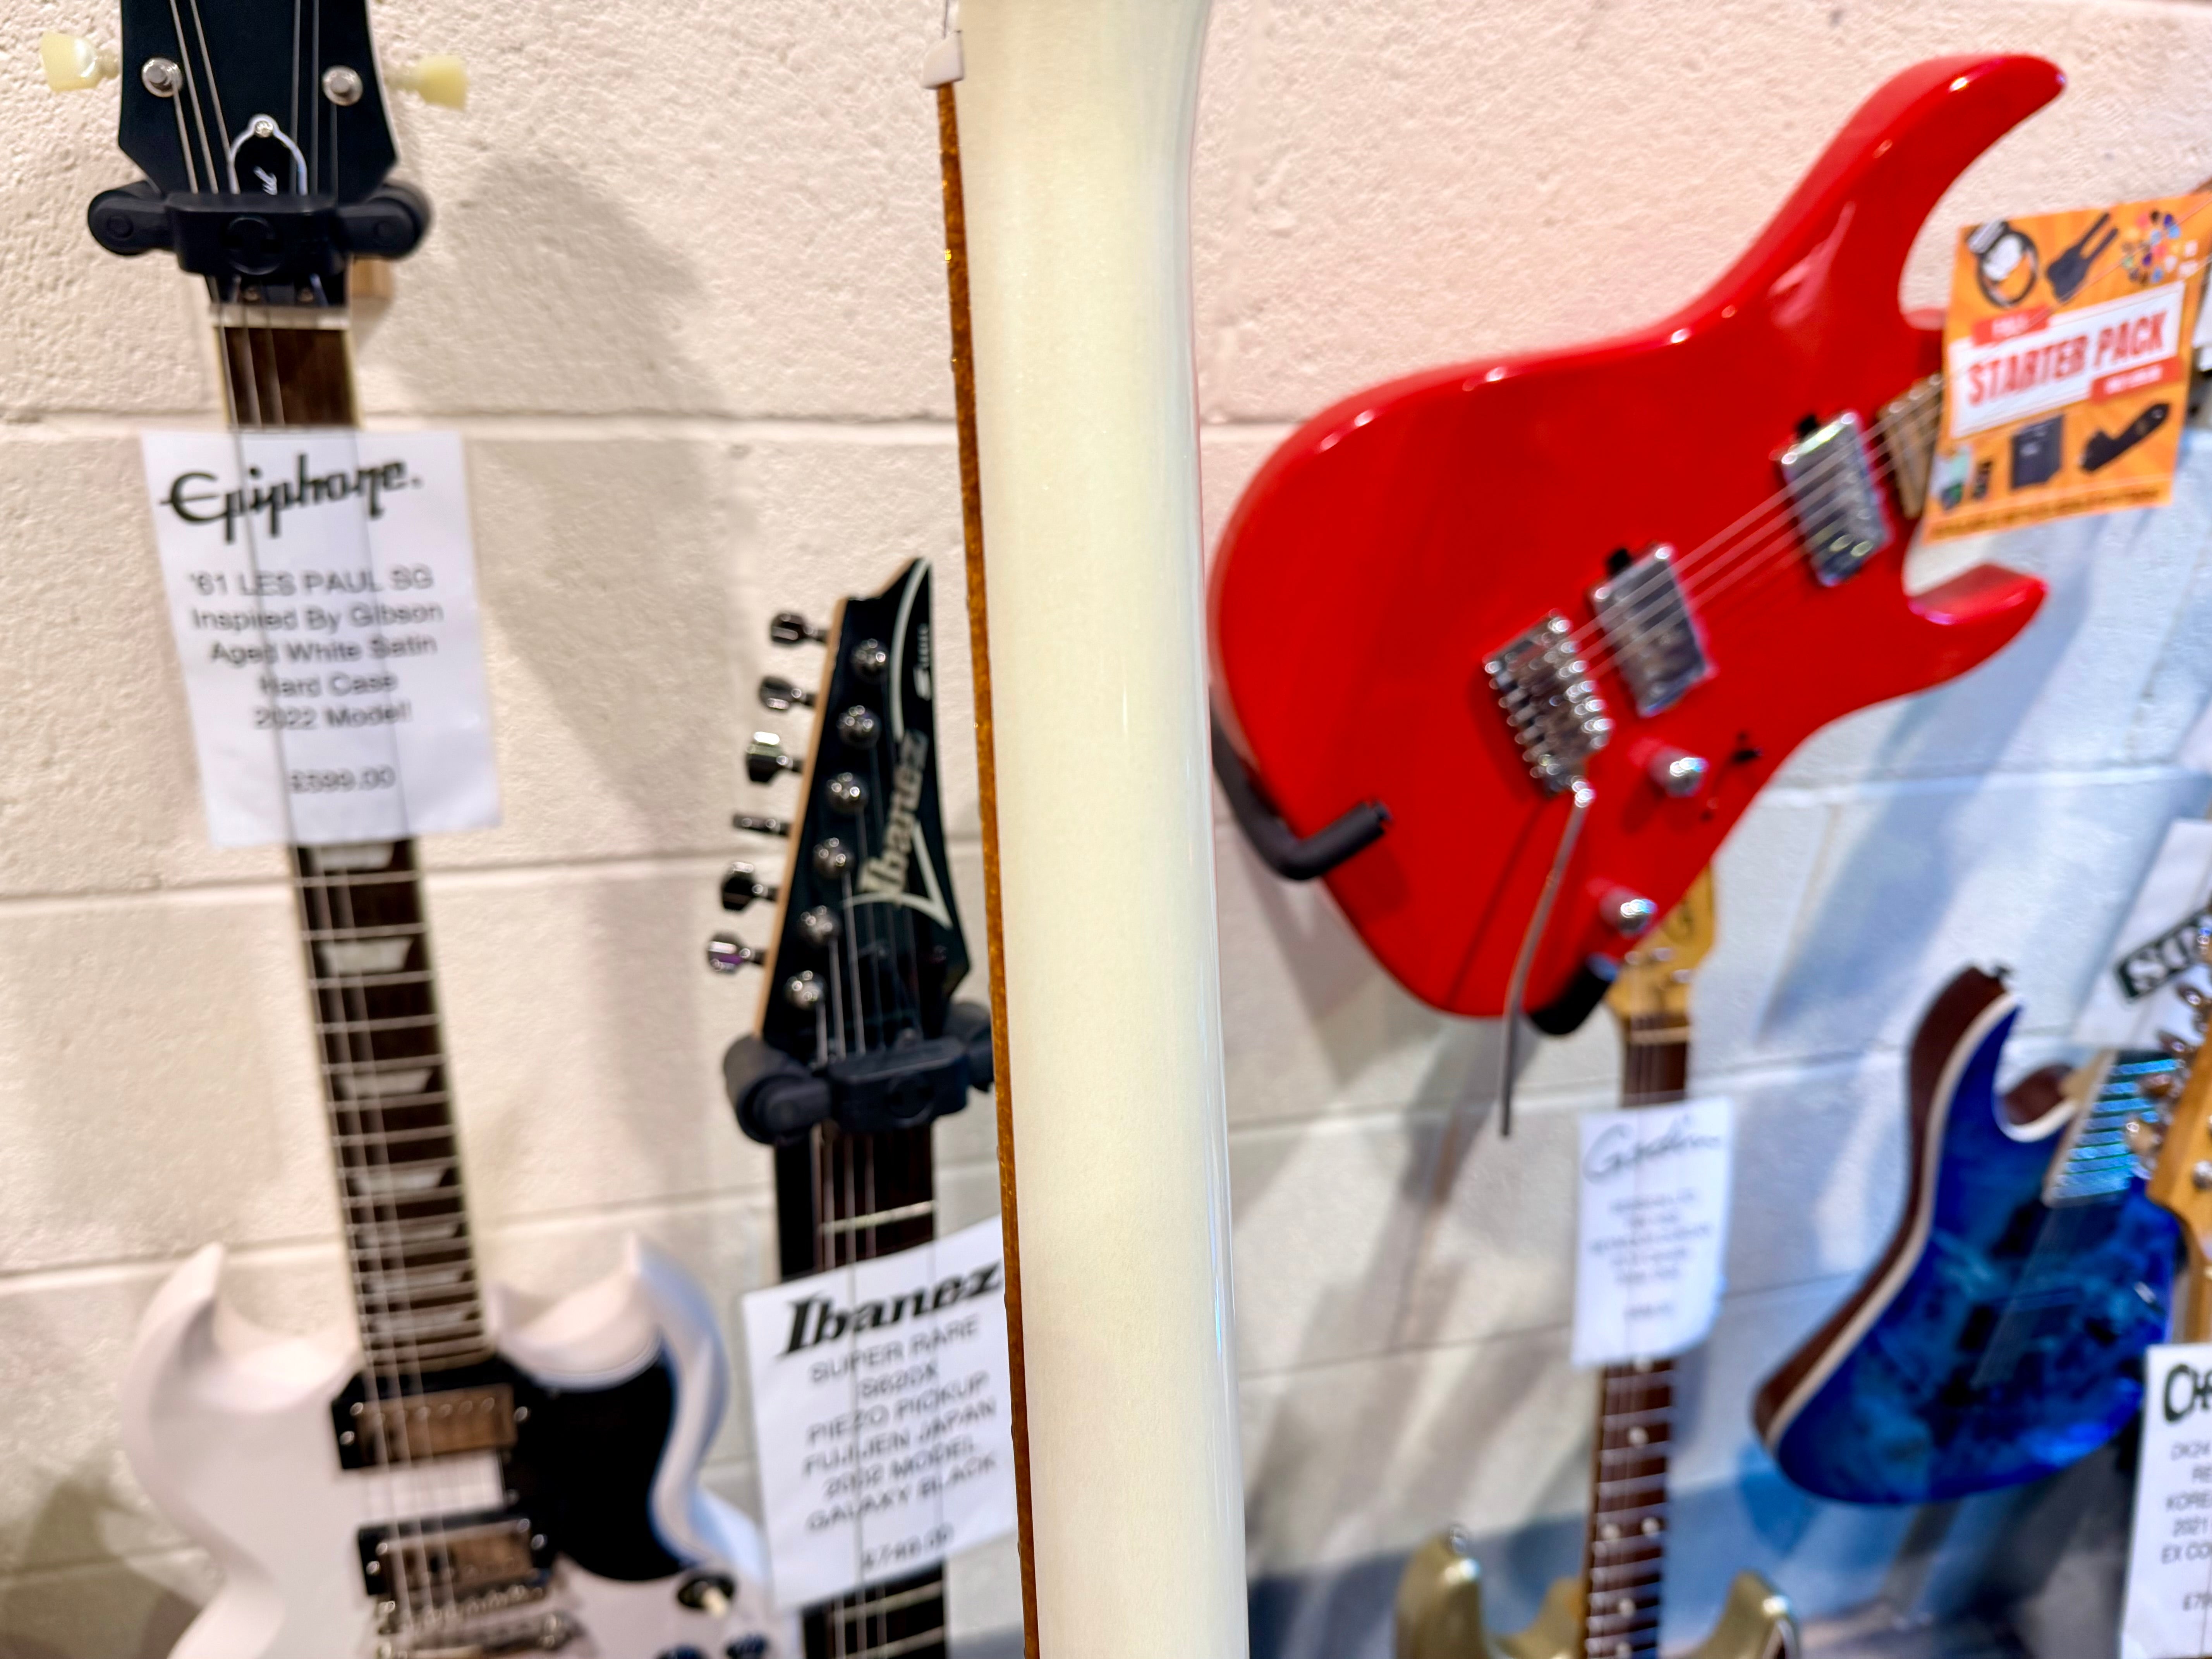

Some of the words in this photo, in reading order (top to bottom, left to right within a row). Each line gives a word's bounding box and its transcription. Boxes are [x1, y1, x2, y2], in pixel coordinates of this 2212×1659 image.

[1968, 335, 2089, 407] STARTER
[2093, 312, 2166, 369] PACK
[239, 571, 297, 596] LES
[305, 569, 382, 594] PAUL
[389, 565, 434, 589] SG
[191, 607, 297, 635] Inspired
[307, 607, 341, 634] By
[351, 602, 443, 629] Gibson
[210, 639, 278, 667] Aged
[286, 638, 362, 663] White
[369, 635, 438, 659] Satin
[259, 673, 322, 697] Hard
[328, 672, 398, 696] Case
[255, 705, 316, 729] 2022
[778, 1262, 1003, 1354] Ibanez
[811, 1339, 903, 1384] SUPER
[910, 1316, 979, 1354] RARE
[807, 1405, 889, 1448] PIEZO
[896, 1370, 989, 1416] PICKUP
[918, 1396, 996, 1442] JAPAN
[888, 1434, 974, 1478] MODEL
[807, 1487, 910, 1533] GALAXY
[916, 1451, 996, 1497] BLACK
